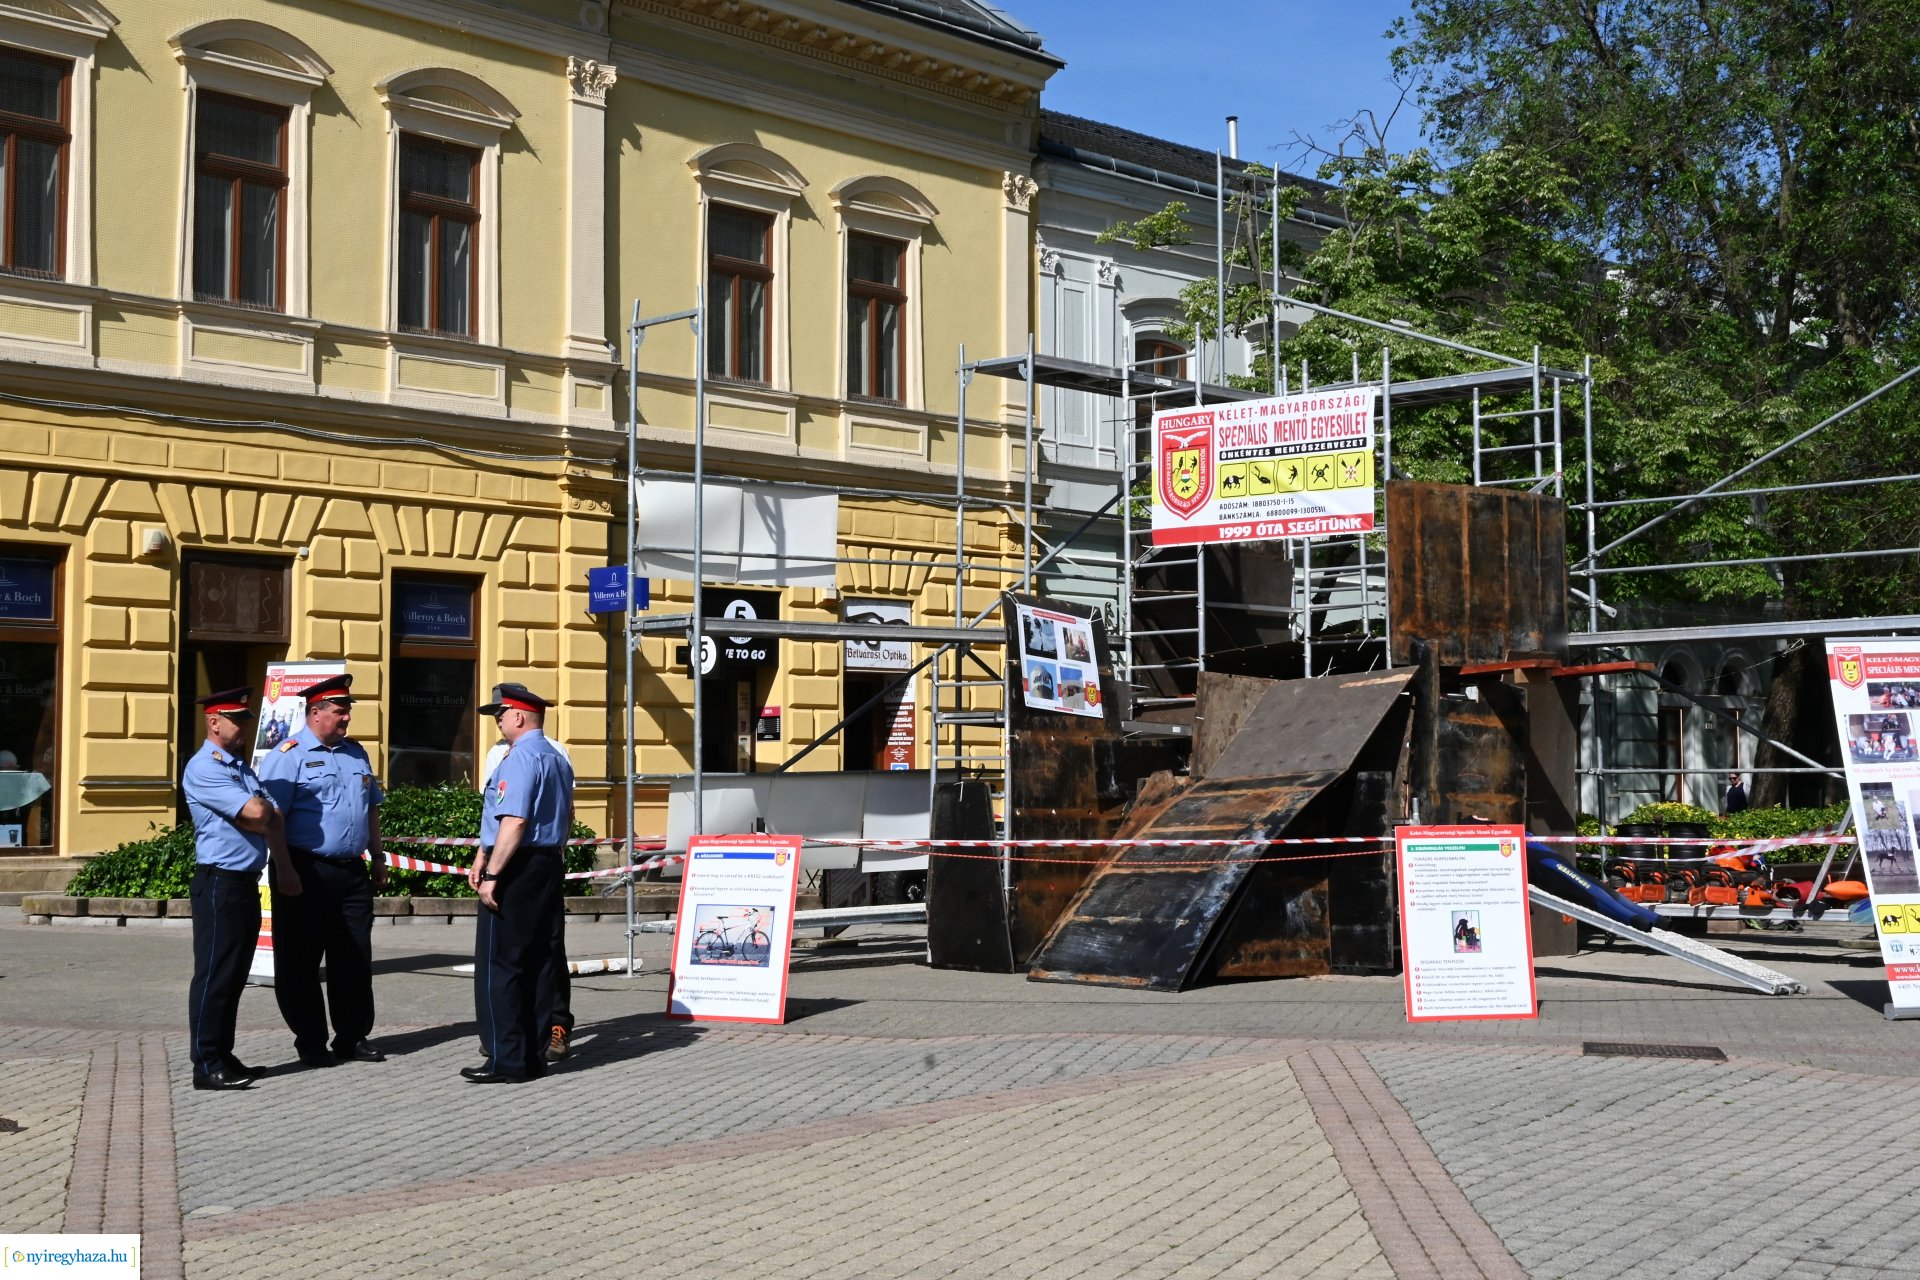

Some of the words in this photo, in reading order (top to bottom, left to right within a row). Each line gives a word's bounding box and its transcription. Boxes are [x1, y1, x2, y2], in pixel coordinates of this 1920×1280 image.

[1160, 414, 1212, 430] HUNGARY
[1219, 420, 1268, 448] SPECIÁLIS
[1273, 413, 1308, 443] MENTŐ
[1311, 409, 1367, 440] EGYESÜLET
[1221, 449, 1271, 460] ÖNKÉNTES
[1274, 439, 1364, 454] MENTŐSZERVEZET
[1219, 525, 1252, 539] 1999
[1256, 523, 1284, 536] ÓTA
[1288, 516, 1362, 533] SEGÍTÜNK
[14, 591, 41, 603] Boch
[594, 591, 615, 600] Villeroy
[402, 611, 435, 622] Villeroy
[436, 614, 443, 622] &
[444, 613, 466, 623] Boch
[736, 649, 749, 659] TO
[751, 649, 766, 660] GO
[846, 648, 880, 659] Belvárosi
[883, 649, 907, 661] Optika
[1867, 665, 1903, 674] SPECIÁLIS
